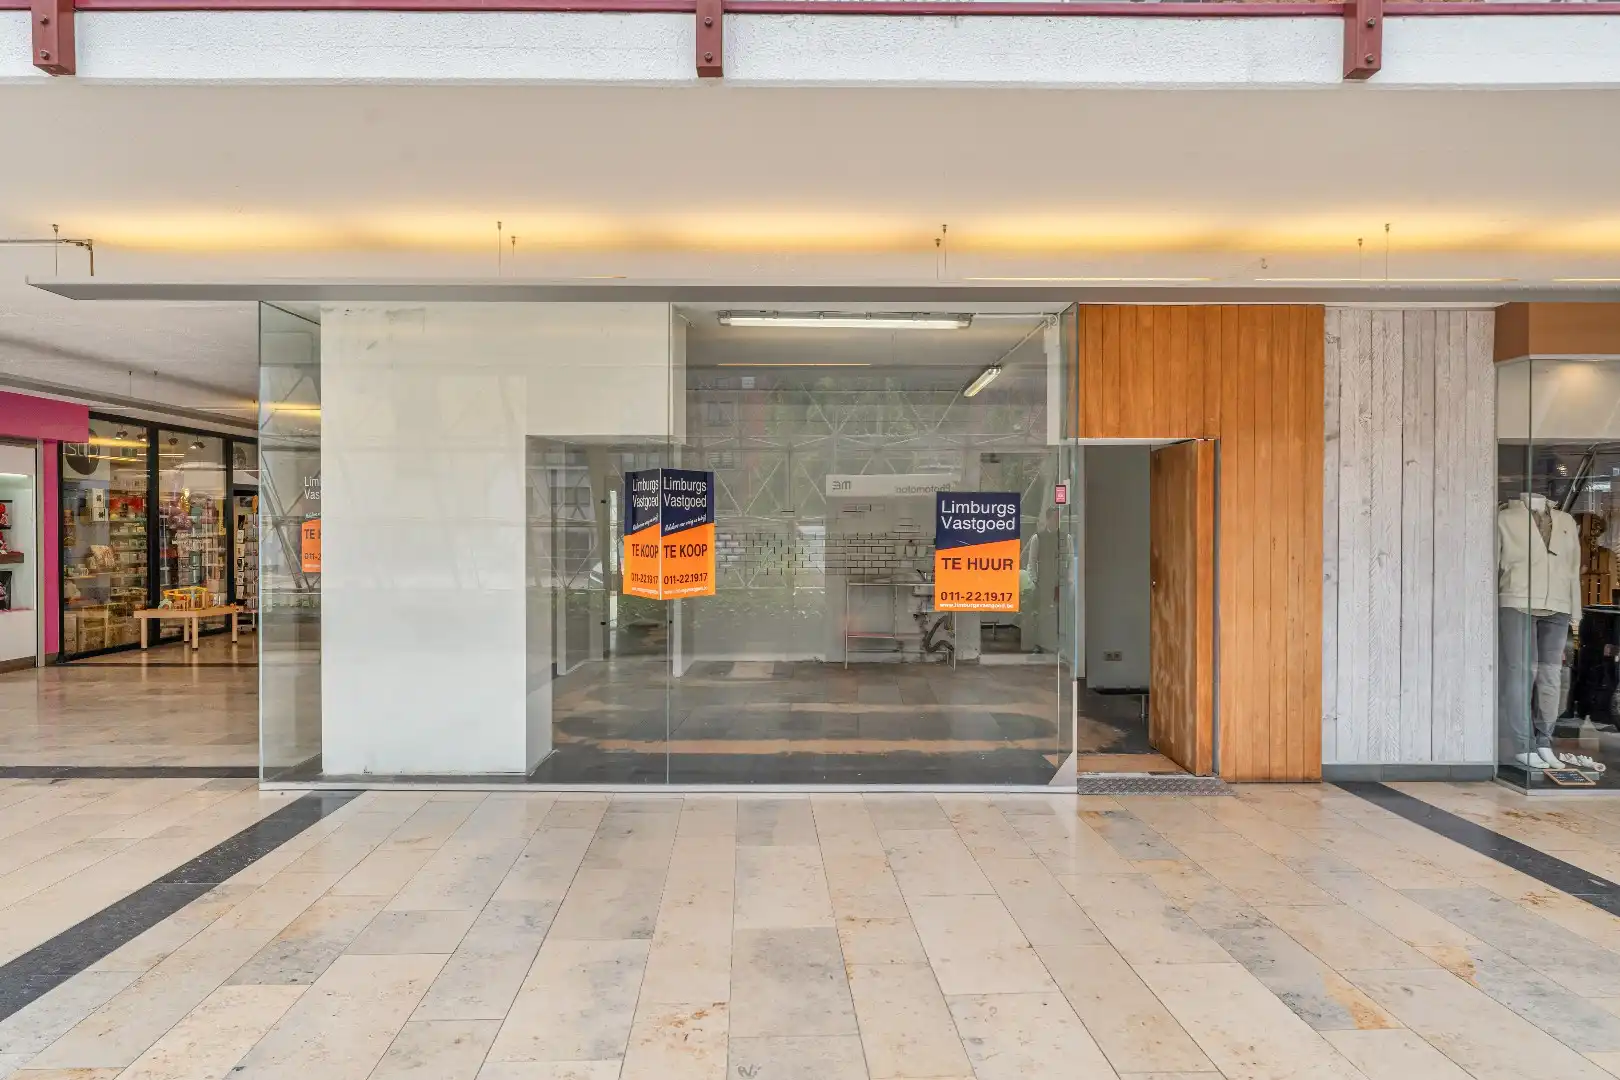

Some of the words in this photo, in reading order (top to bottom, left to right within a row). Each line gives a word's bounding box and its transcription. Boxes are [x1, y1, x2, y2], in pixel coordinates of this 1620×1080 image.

[632, 478, 659, 493] Limburgs
[663, 476, 707, 495] Limburgs
[632, 495, 659, 510] Vastgoed
[663, 493, 707, 510] Vastgoed
[941, 500, 1016, 517] Limburgs
[941, 516, 1016, 533] Vastgoed
[632, 544, 640, 557] TE
[641, 544, 659, 558] KOOP
[664, 545, 677, 558] TE
[680, 544, 708, 558] KOOP
[941, 558, 962, 570] TE
[967, 558, 1014, 571] HUUR
[663, 573, 708, 585] 011-22.19.17
[940, 591, 1013, 602] 011-22.19.17
